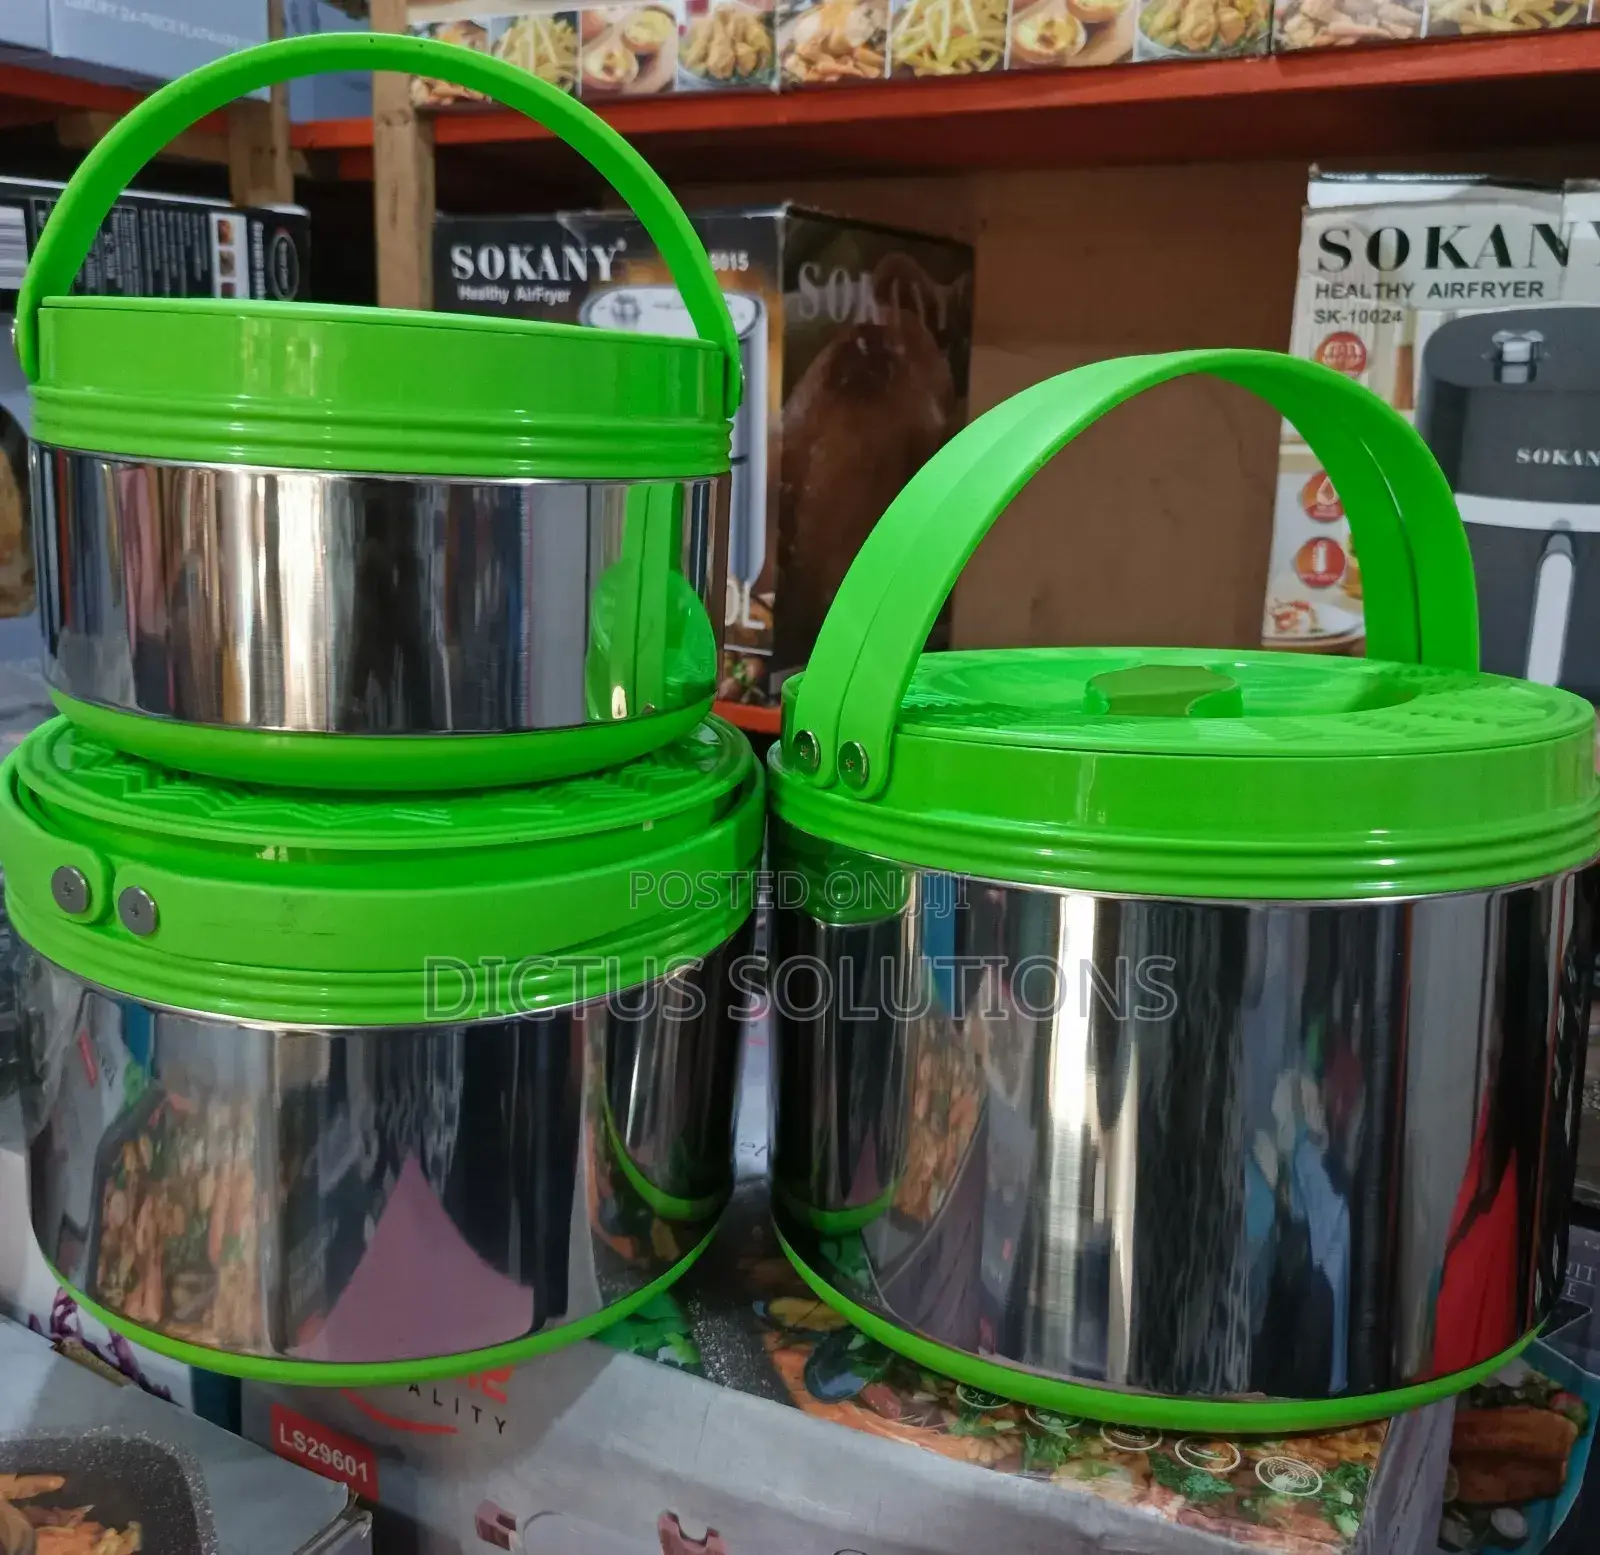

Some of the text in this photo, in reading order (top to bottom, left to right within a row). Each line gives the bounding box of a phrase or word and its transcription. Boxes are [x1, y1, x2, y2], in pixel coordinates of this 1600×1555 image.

[1317, 219, 1600, 274] SOKAN
[451, 244, 617, 282] SOKANY
[457, 284, 571, 307] Healthy AirFryer
[1315, 280, 1544, 300] HEALTHY AIRFRYER
[1313, 308, 1404, 325] SK-10024
[279, 1422, 369, 1483] LS29601
